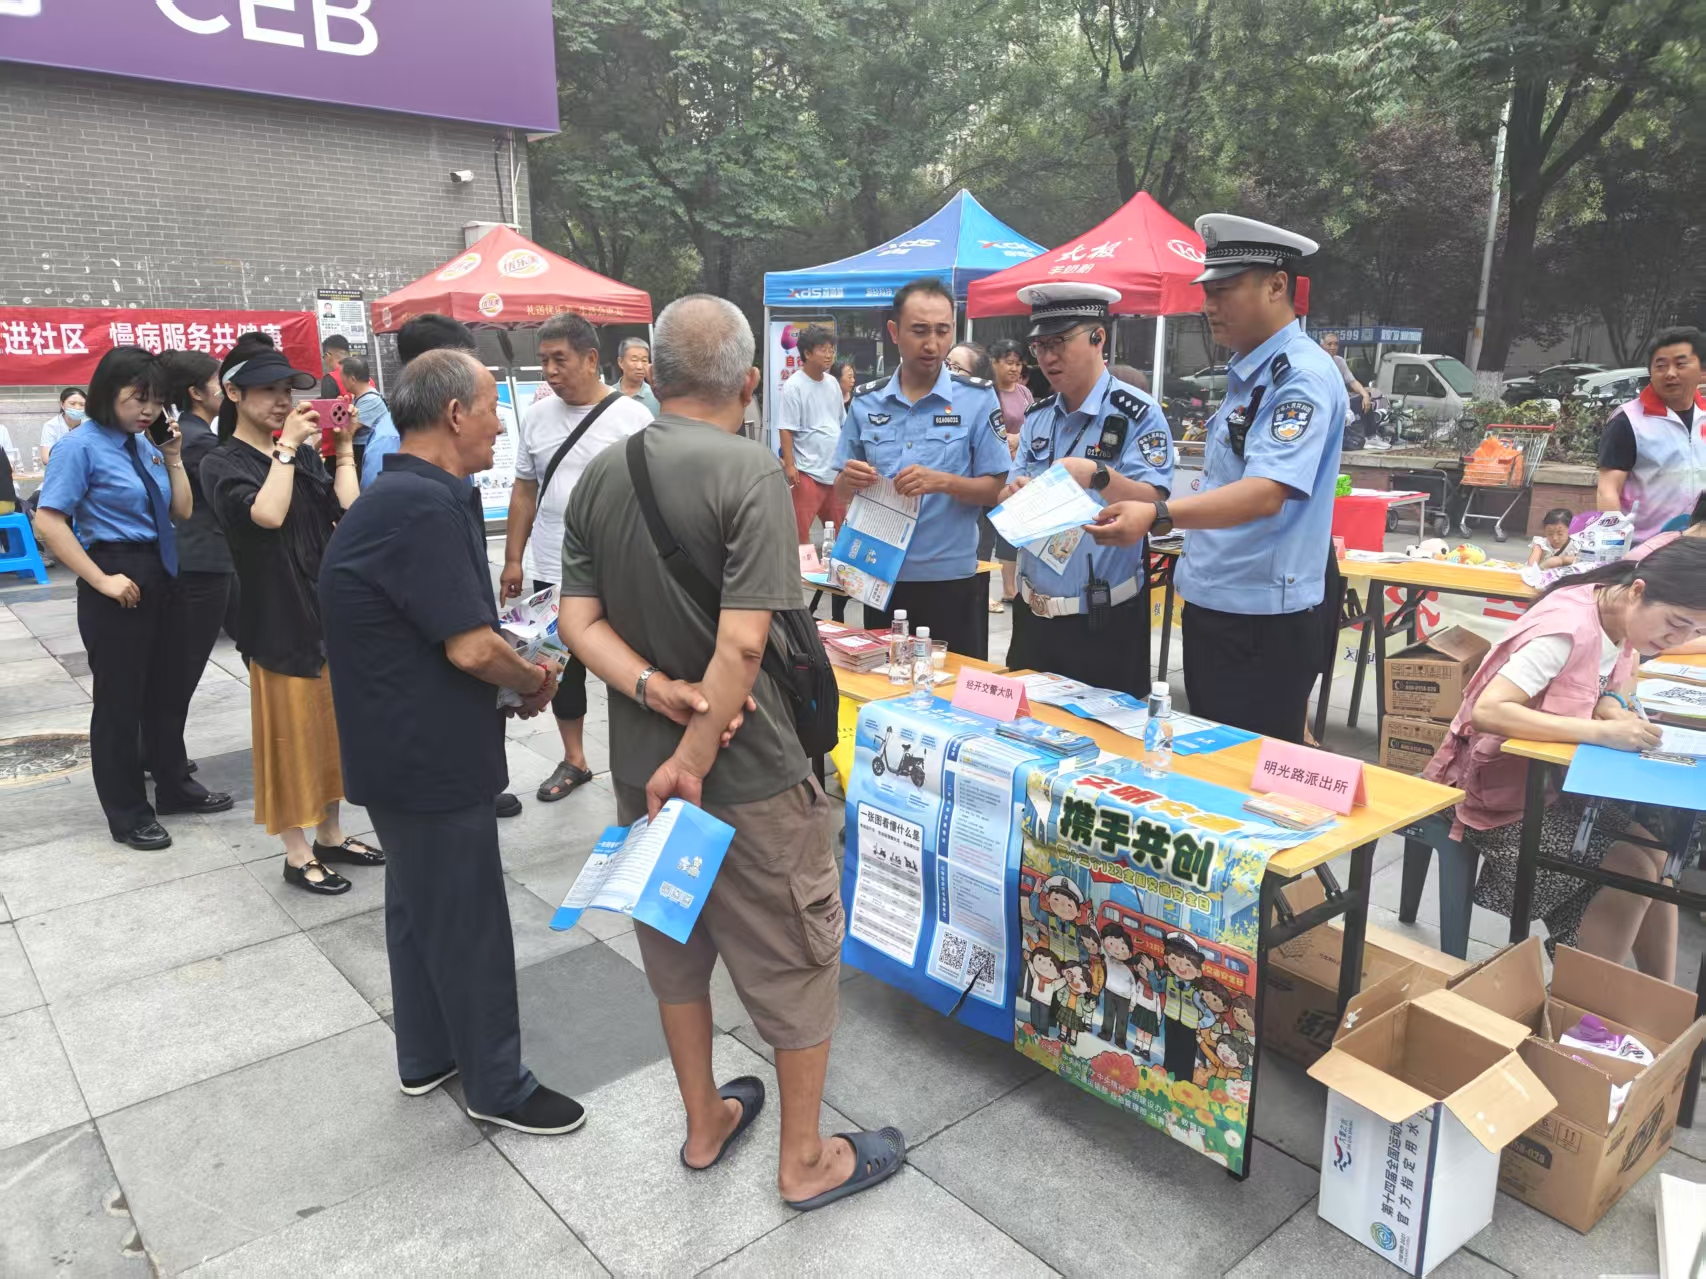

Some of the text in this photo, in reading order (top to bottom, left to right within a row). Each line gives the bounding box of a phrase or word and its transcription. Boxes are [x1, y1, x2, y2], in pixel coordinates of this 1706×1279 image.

[965, 679, 1013, 700] 经开交警大队
[1263, 759, 1349, 795] 明光路派出所
[860, 810, 920, 842] 一张图看懂什么是
[1060, 795, 1216, 888] 携手共创
[1396, 1122, 1419, 1227] 官方指定用水
